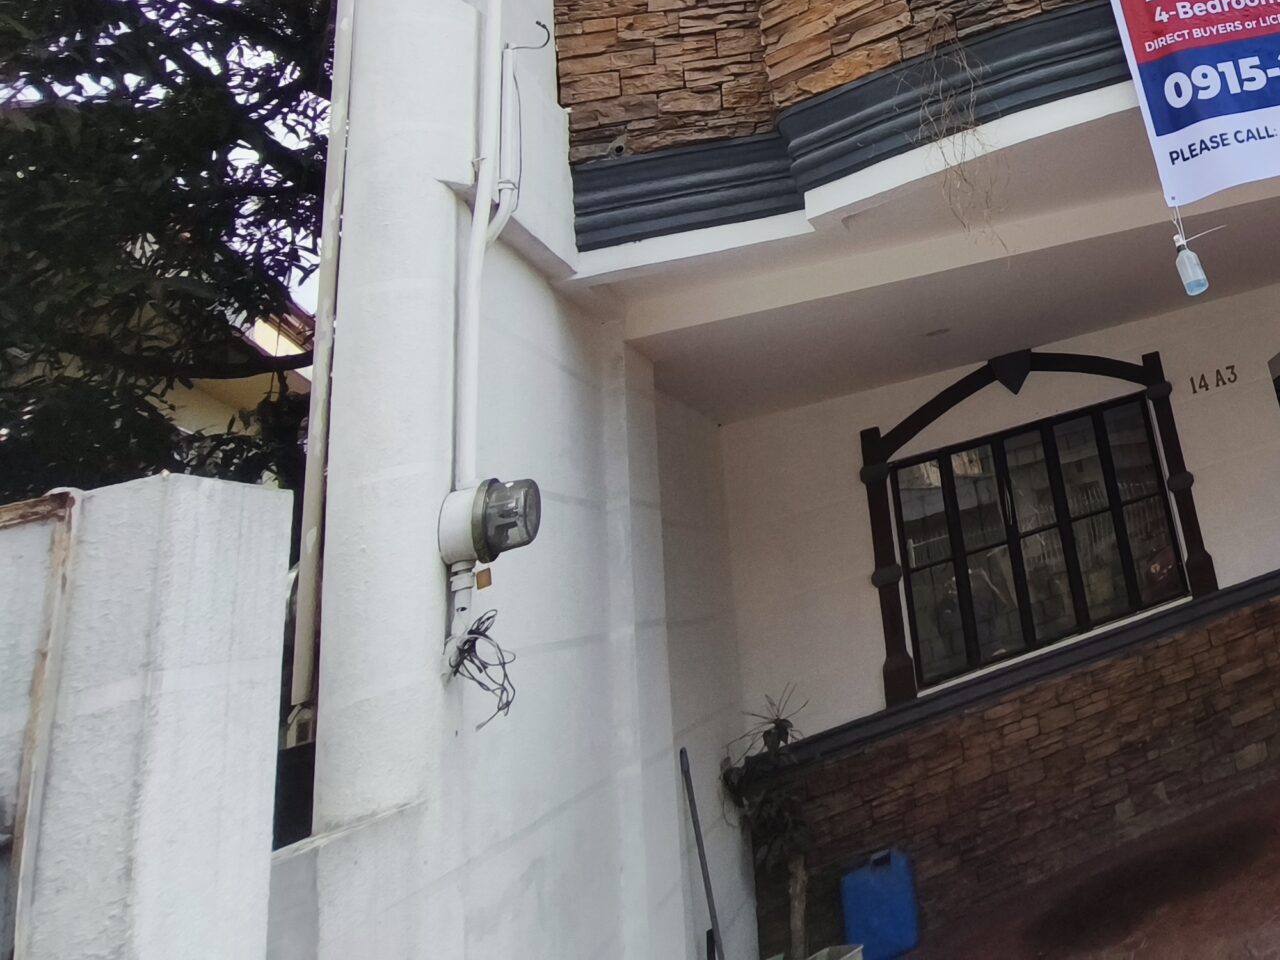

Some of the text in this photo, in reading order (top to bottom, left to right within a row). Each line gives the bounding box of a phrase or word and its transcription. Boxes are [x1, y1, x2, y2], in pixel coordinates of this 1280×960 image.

[1144, 29, 1190, 52] DIRECT
[1191, 20, 1243, 39] BUYERS
[1245, 20, 1257, 29] or
[1168, 132, 1231, 166] PLEASE
[1189, 364, 1238, 394] 14 A3
